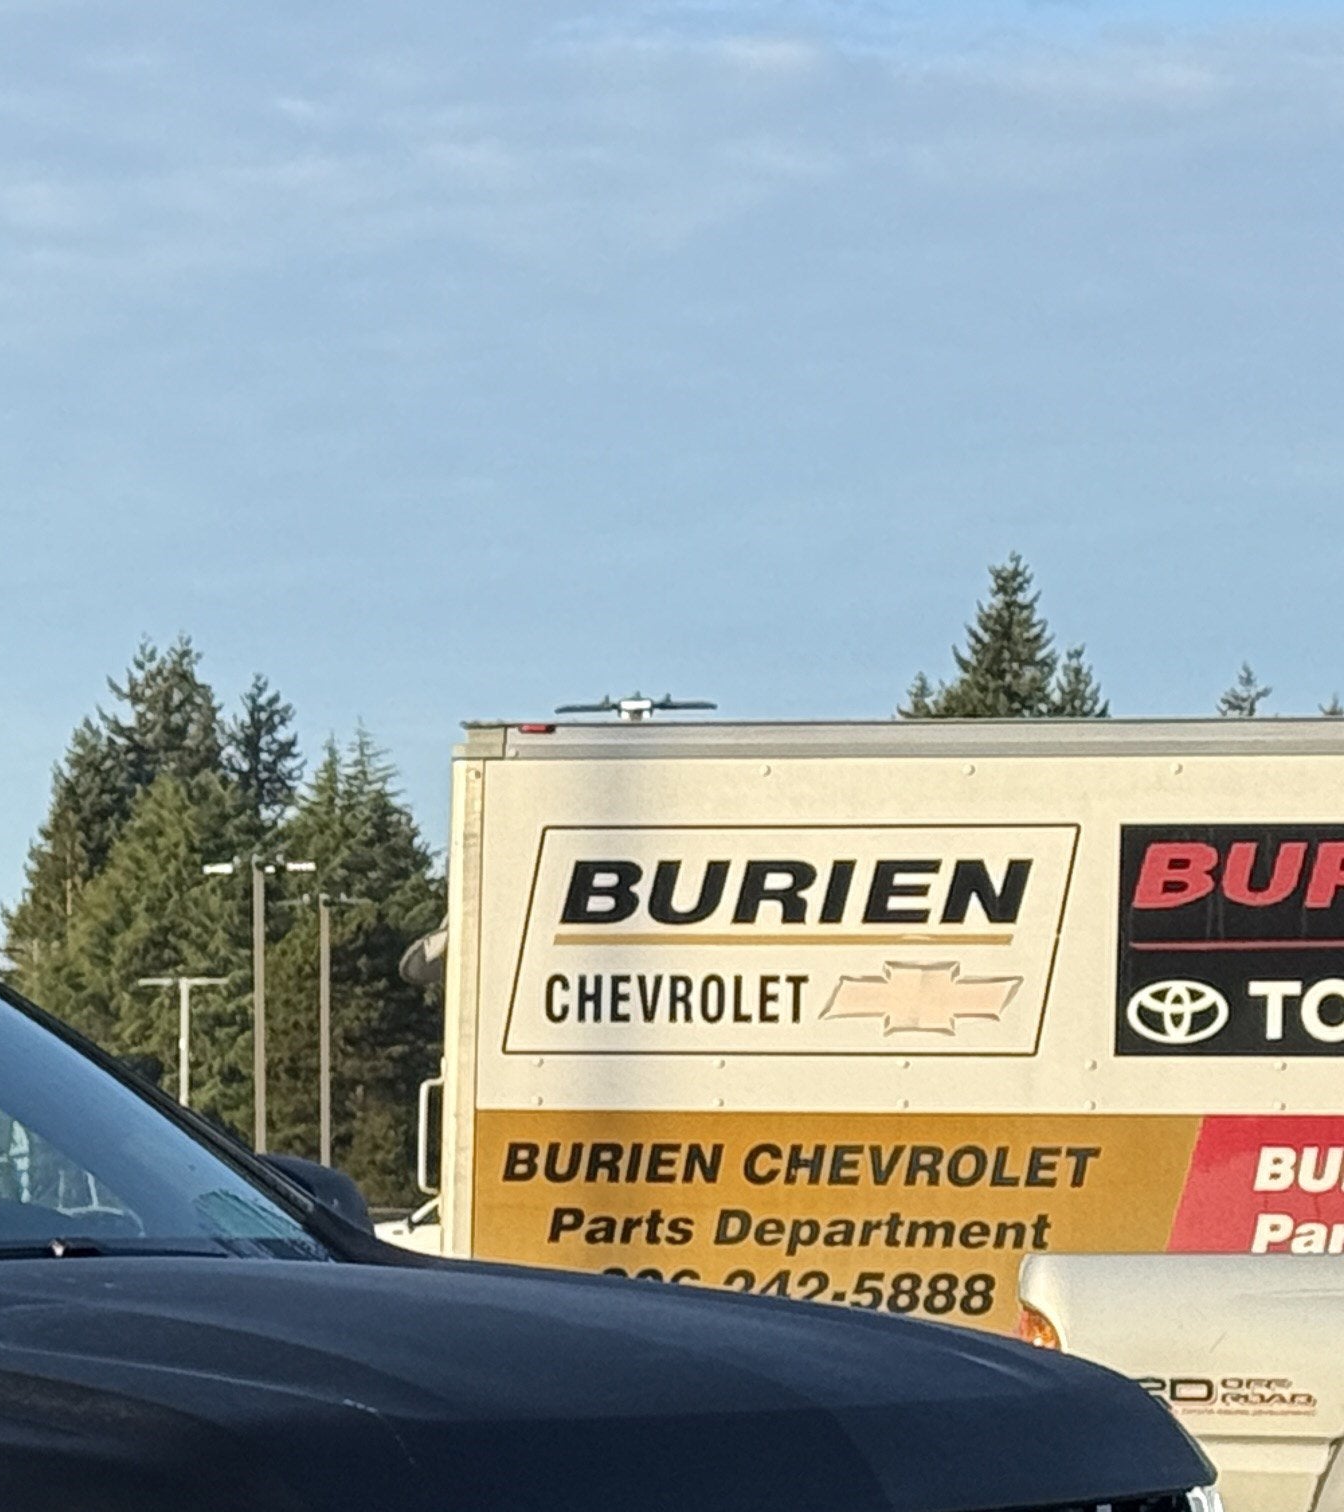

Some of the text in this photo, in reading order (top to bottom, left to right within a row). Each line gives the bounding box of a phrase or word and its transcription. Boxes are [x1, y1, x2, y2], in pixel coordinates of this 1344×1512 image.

[559, 858, 1034, 926] BURIEN
[544, 972, 810, 1025] CHEVROLET
[501, 1141, 1102, 1189] BURIEN CHEVROLET
[1252, 1146, 1344, 1194] BU
[547, 1207, 1052, 1257] Parts Department
